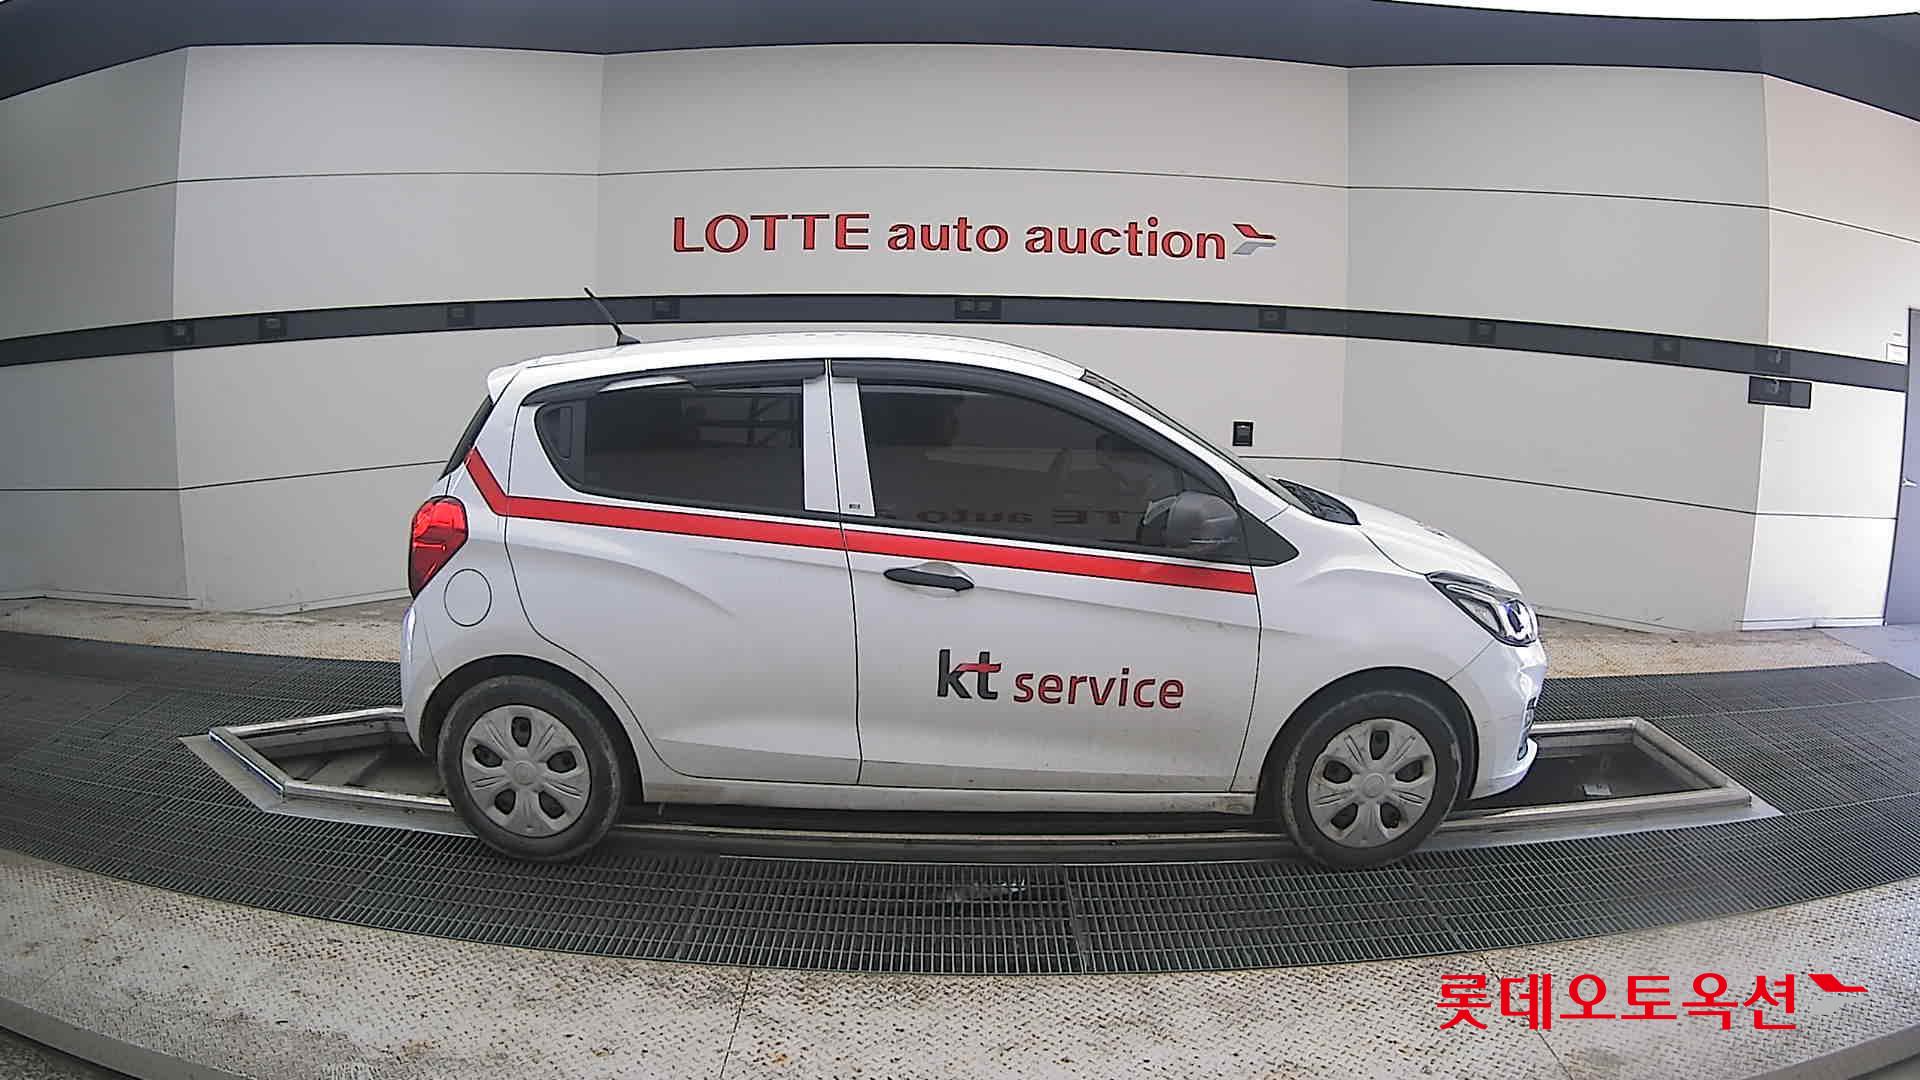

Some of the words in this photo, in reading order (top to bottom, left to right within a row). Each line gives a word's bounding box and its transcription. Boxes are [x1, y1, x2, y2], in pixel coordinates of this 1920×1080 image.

[673, 213, 869, 252] LOTTE
[888, 216, 1009, 252] auto
[1025, 217, 1226, 259] auction
[937, 649, 1002, 700] kt
[1013, 667, 1184, 708] service
